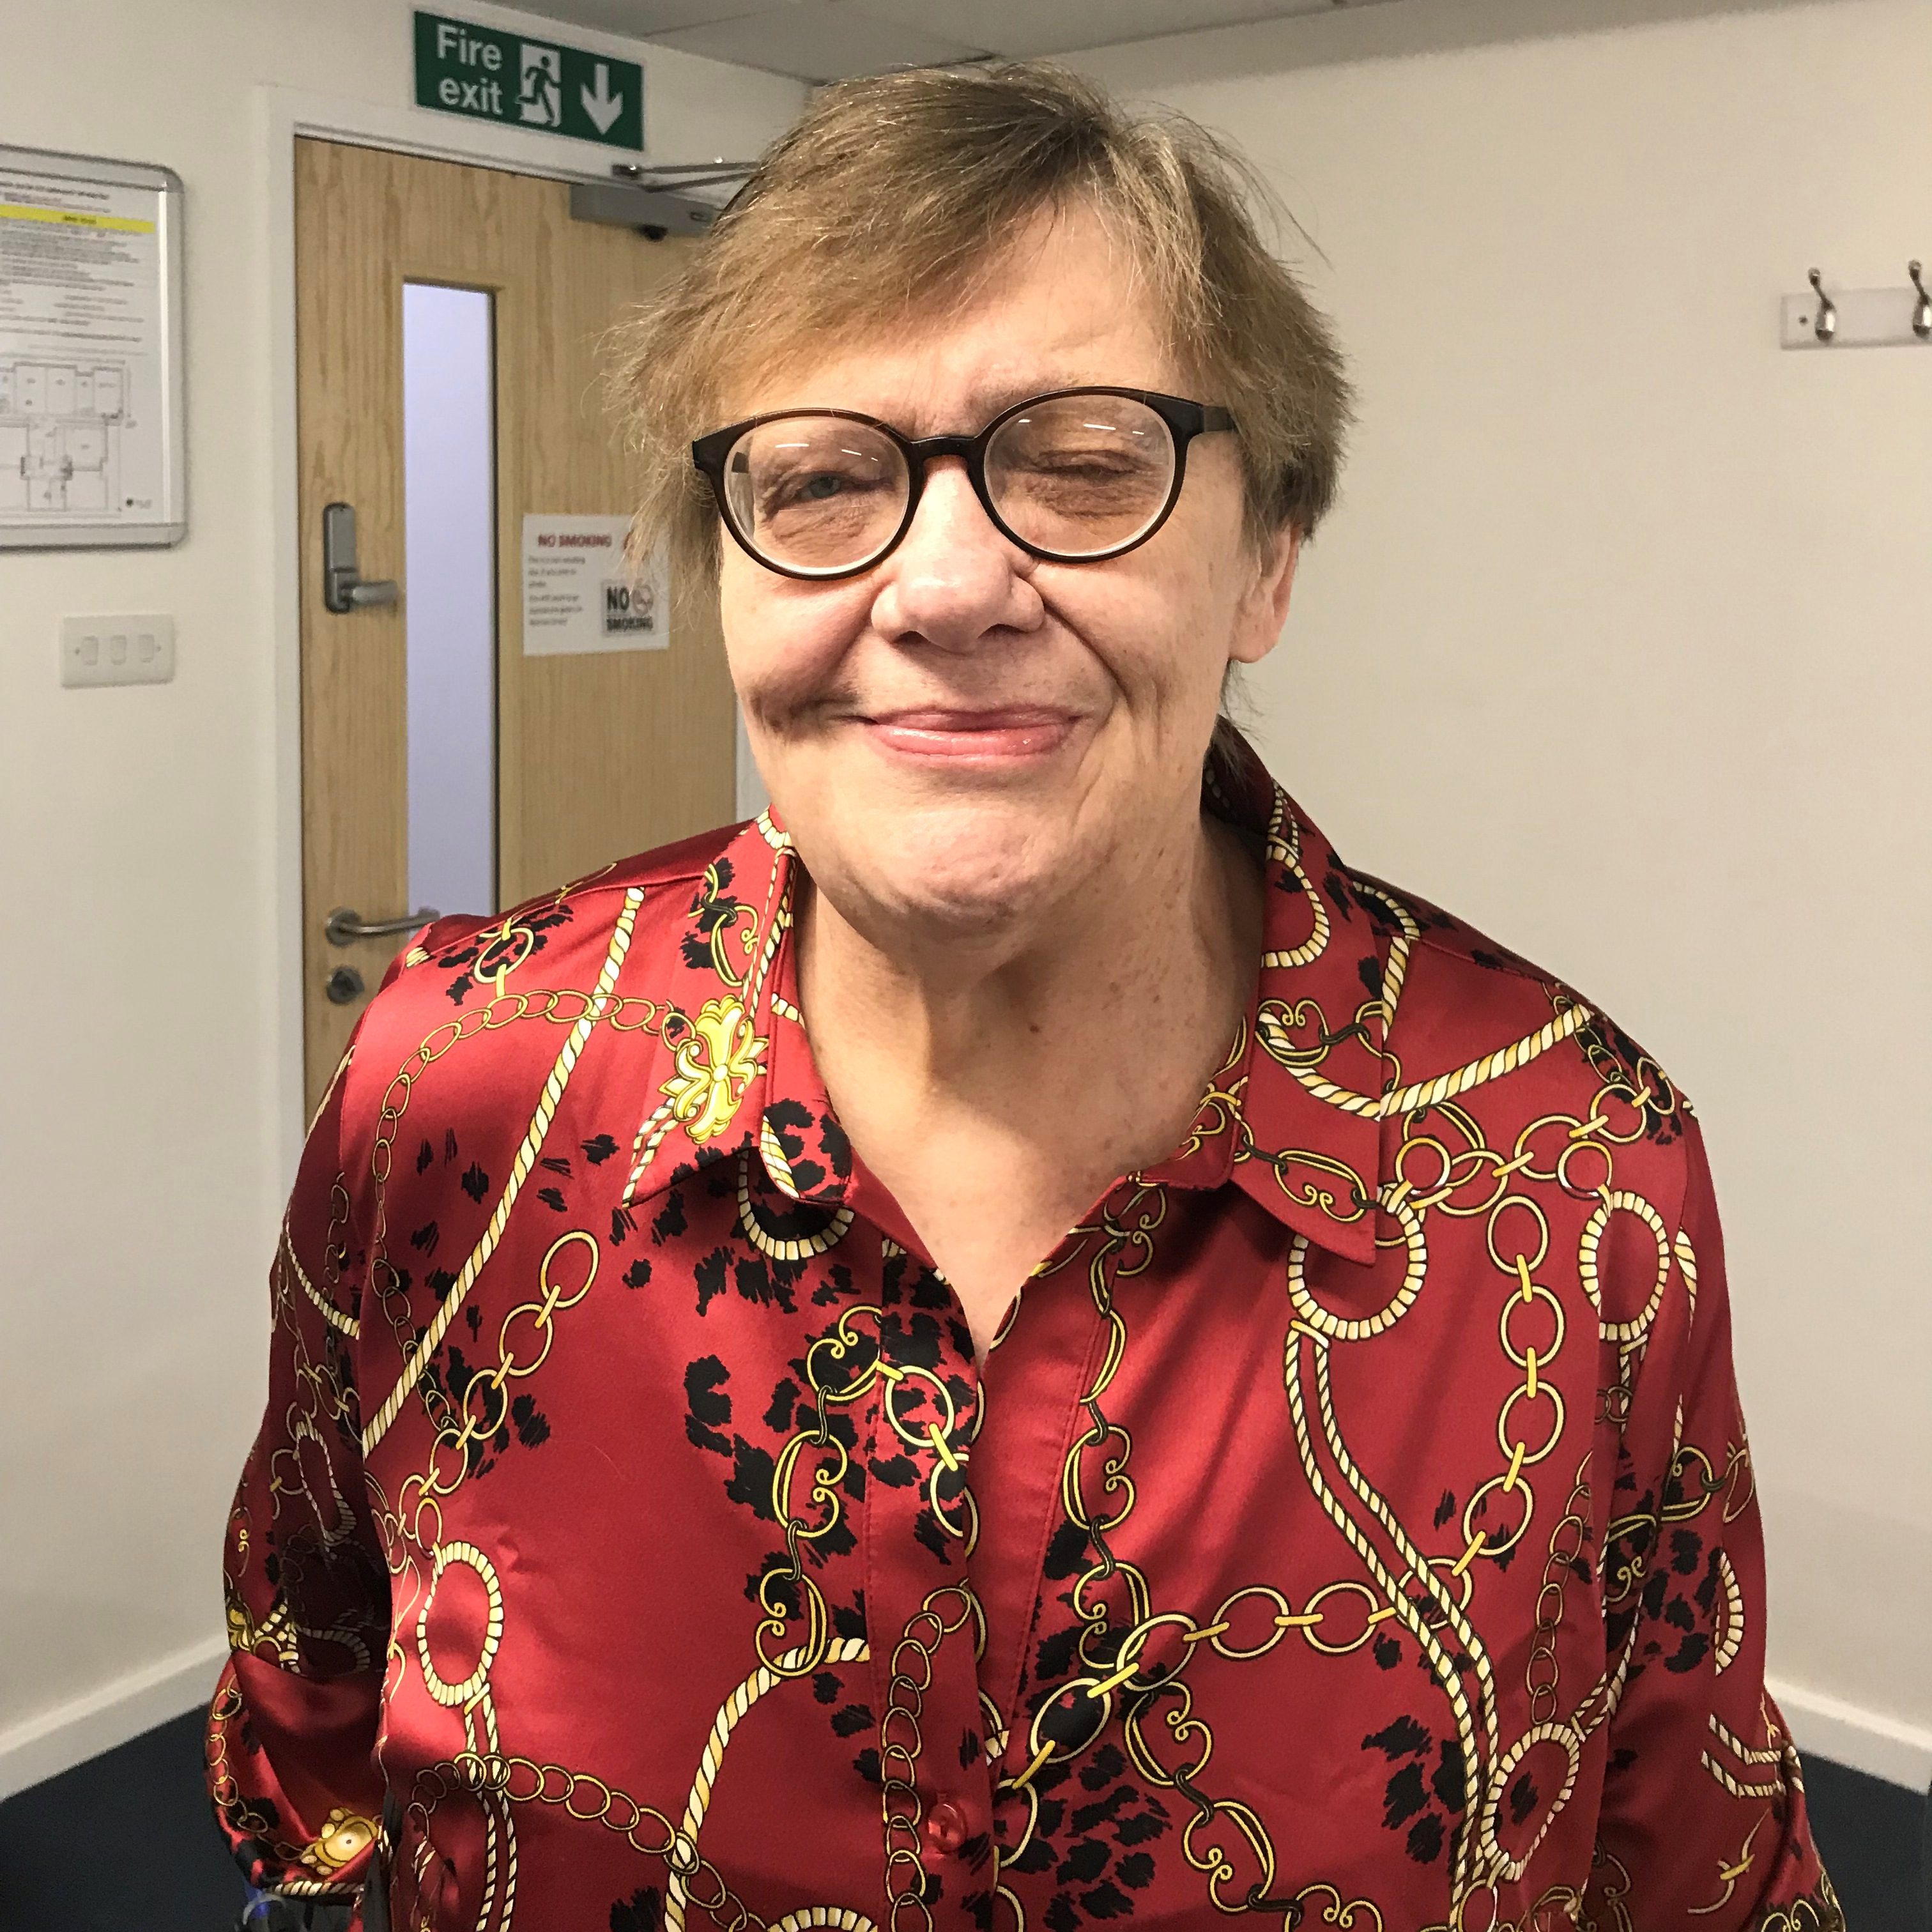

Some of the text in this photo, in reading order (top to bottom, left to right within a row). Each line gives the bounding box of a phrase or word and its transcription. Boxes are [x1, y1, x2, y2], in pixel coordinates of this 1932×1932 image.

[437, 24, 502, 71] Fire
[440, 77, 503, 116] exit
[538, 534, 611, 548] NO SMOKING
[606, 586, 630, 611] NO
[606, 617, 653, 631] SMOKING
